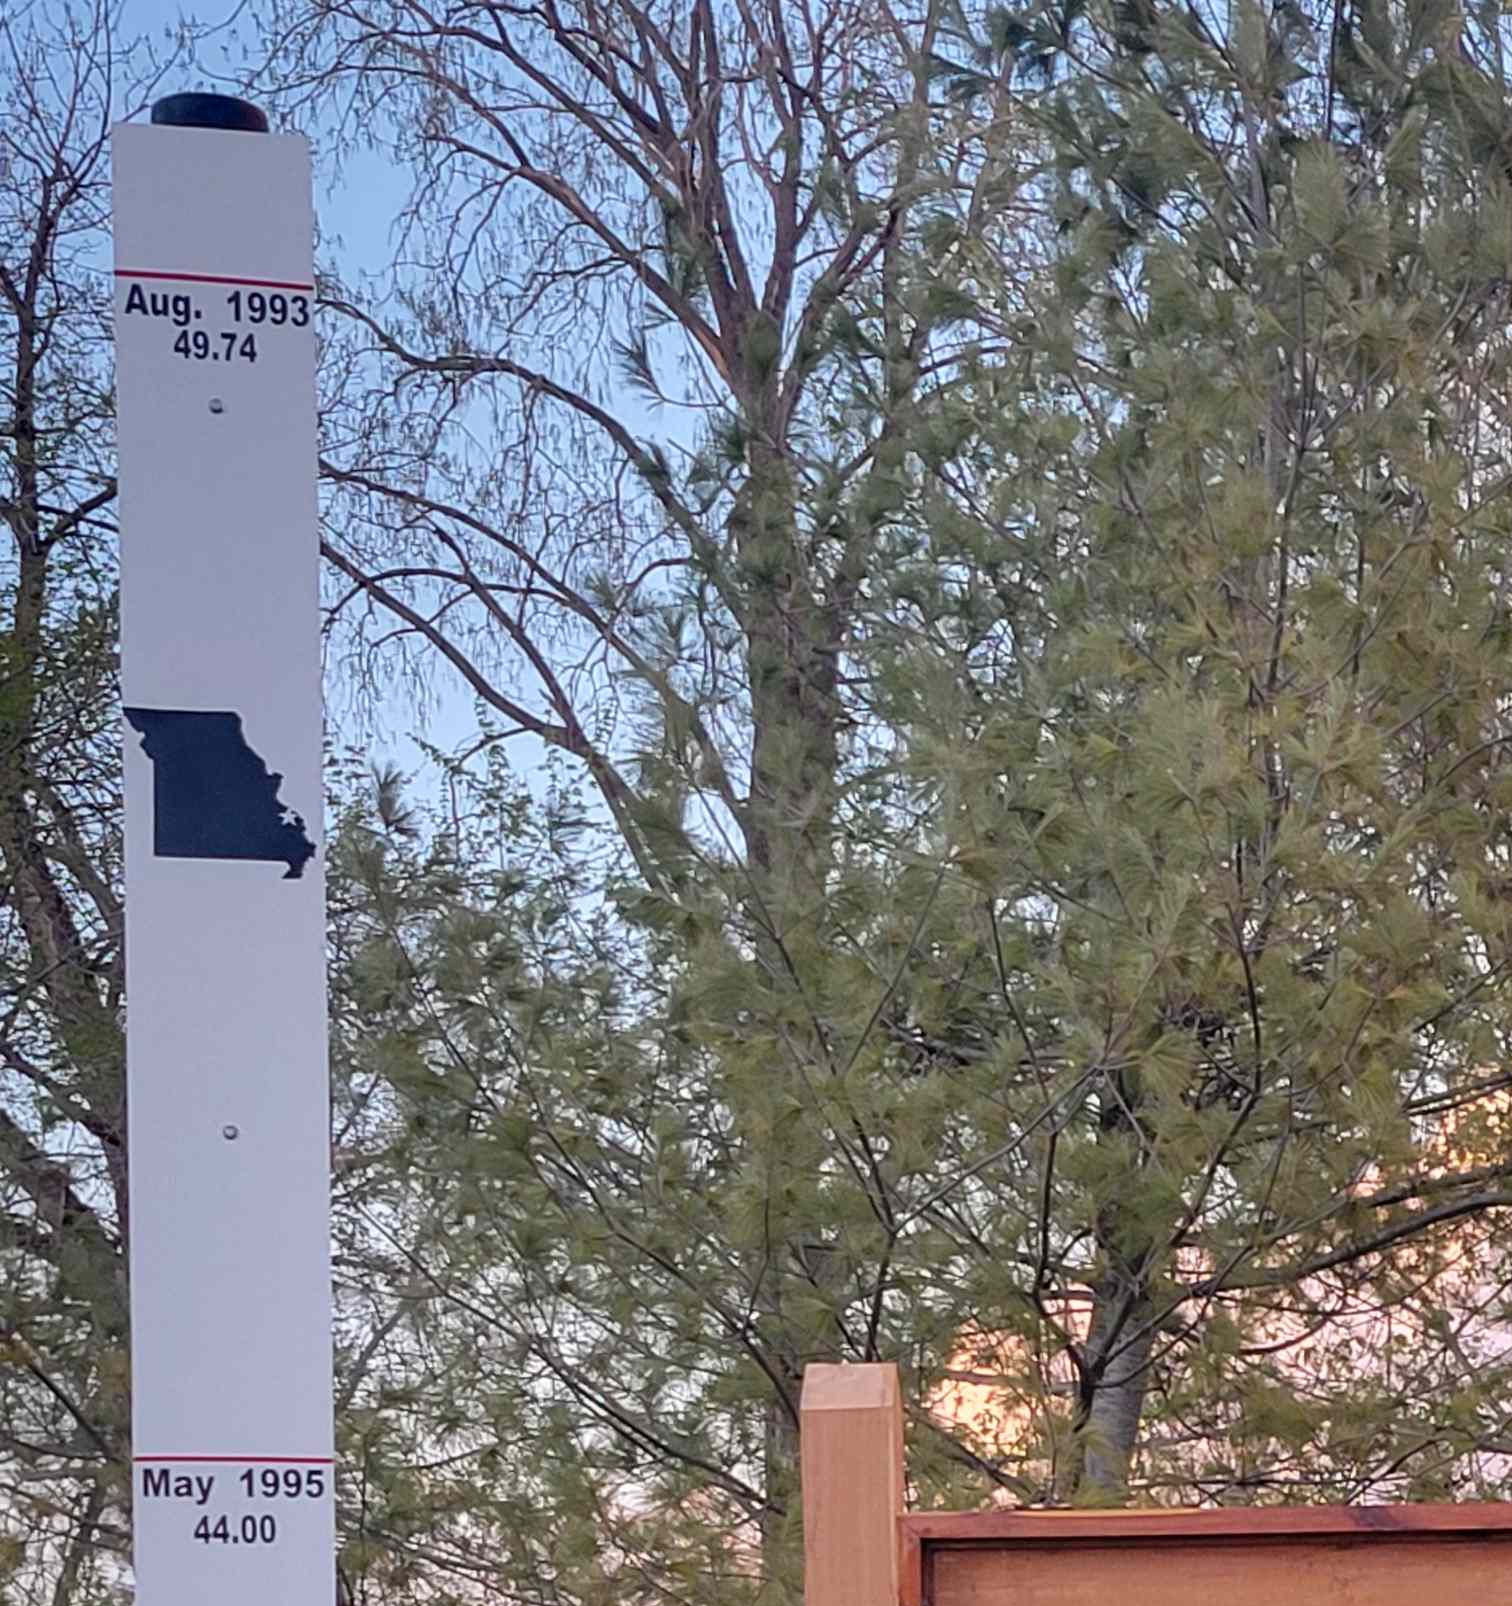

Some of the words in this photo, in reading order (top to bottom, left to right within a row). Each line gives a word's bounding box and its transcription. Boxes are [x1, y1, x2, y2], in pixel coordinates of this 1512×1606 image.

[125, 283, 202, 326] Aug.
[227, 290, 310, 326] 1993
[174, 330, 257, 362] 49.74
[143, 1469, 214, 1504] May
[240, 1469, 324, 1498] 1995
[194, 1514, 276, 1544] 44.00
